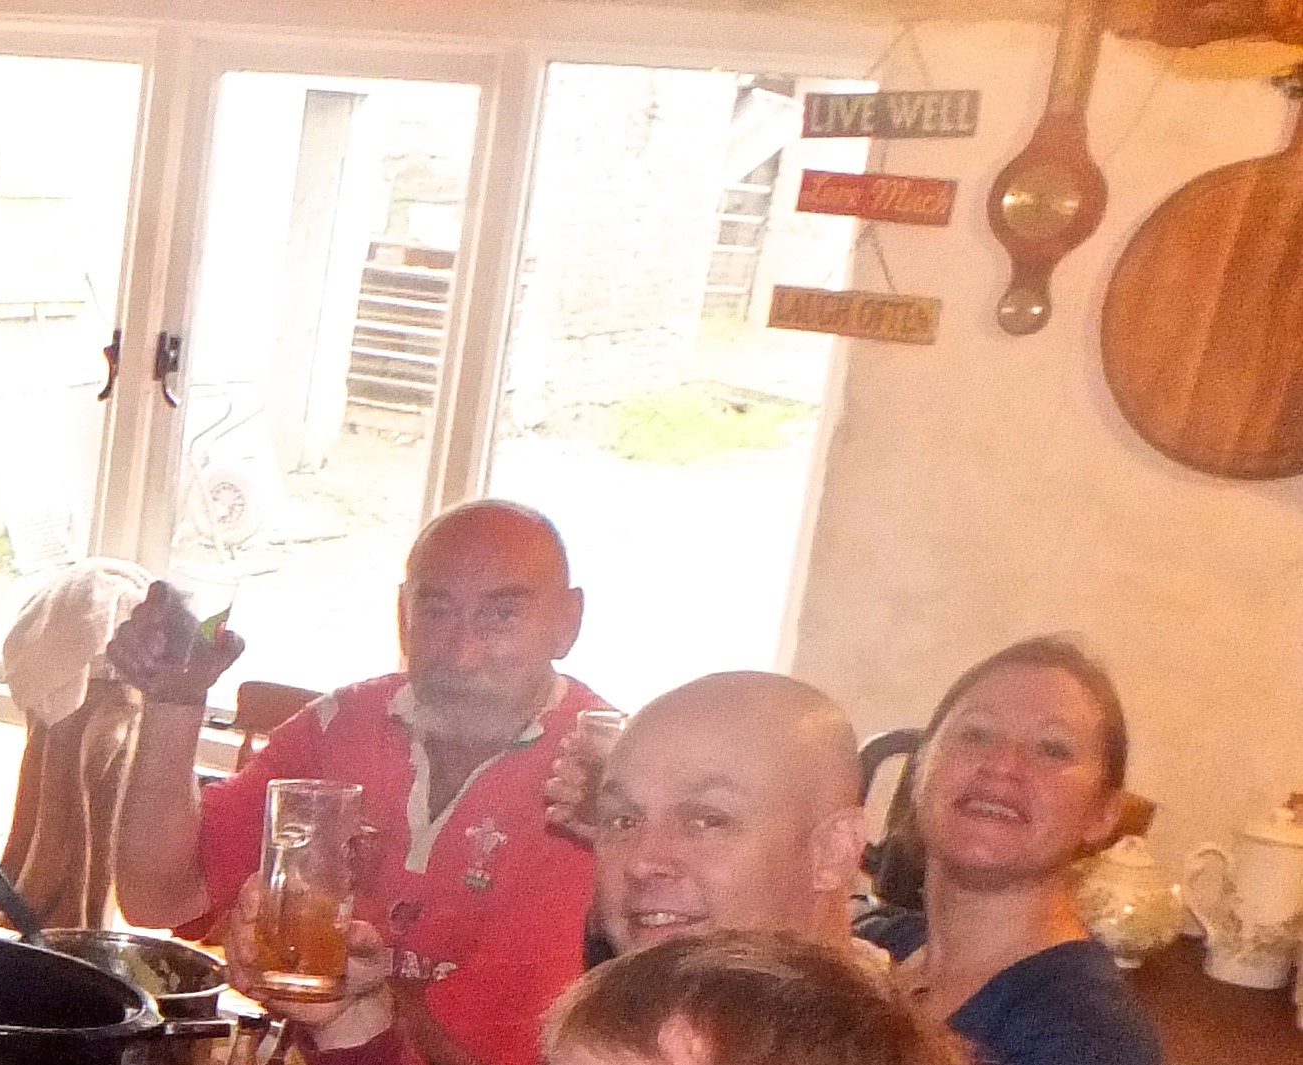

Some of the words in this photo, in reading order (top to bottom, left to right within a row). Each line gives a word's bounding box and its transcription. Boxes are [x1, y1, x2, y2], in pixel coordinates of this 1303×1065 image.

[809, 93, 877, 134] LIVE
[891, 90, 975, 133] WELL
[871, 178, 951, 216] Much
